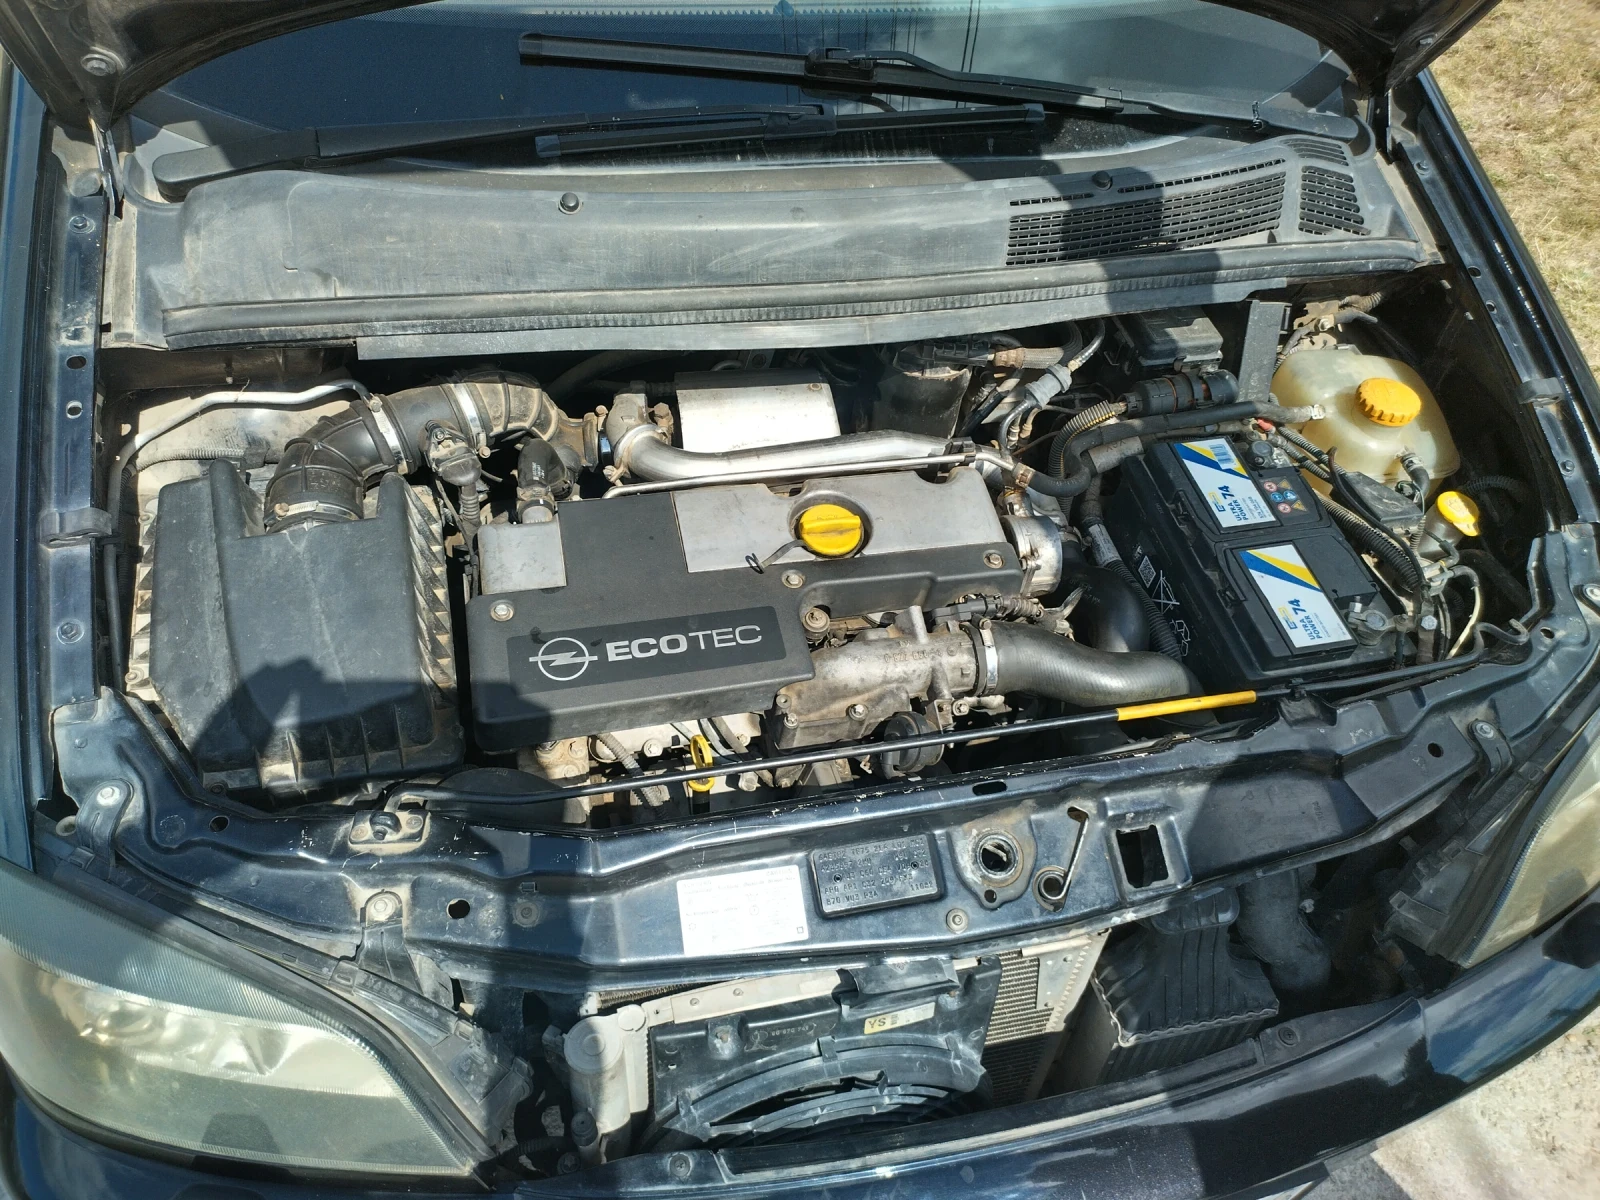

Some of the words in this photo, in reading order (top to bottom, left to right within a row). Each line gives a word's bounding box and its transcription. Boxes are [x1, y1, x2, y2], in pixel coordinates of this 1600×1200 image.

[1217, 485, 1235, 499] 74
[1228, 502, 1242, 521] ULTRA
[1232, 499, 1248, 520] POWER
[1288, 598, 1306, 615] 74
[1300, 618, 1315, 640] ULTRA
[1304, 615, 1322, 639] POWER
[605, 624, 762, 662] ECOTEC
[868, 1018, 886, 1028] YS
